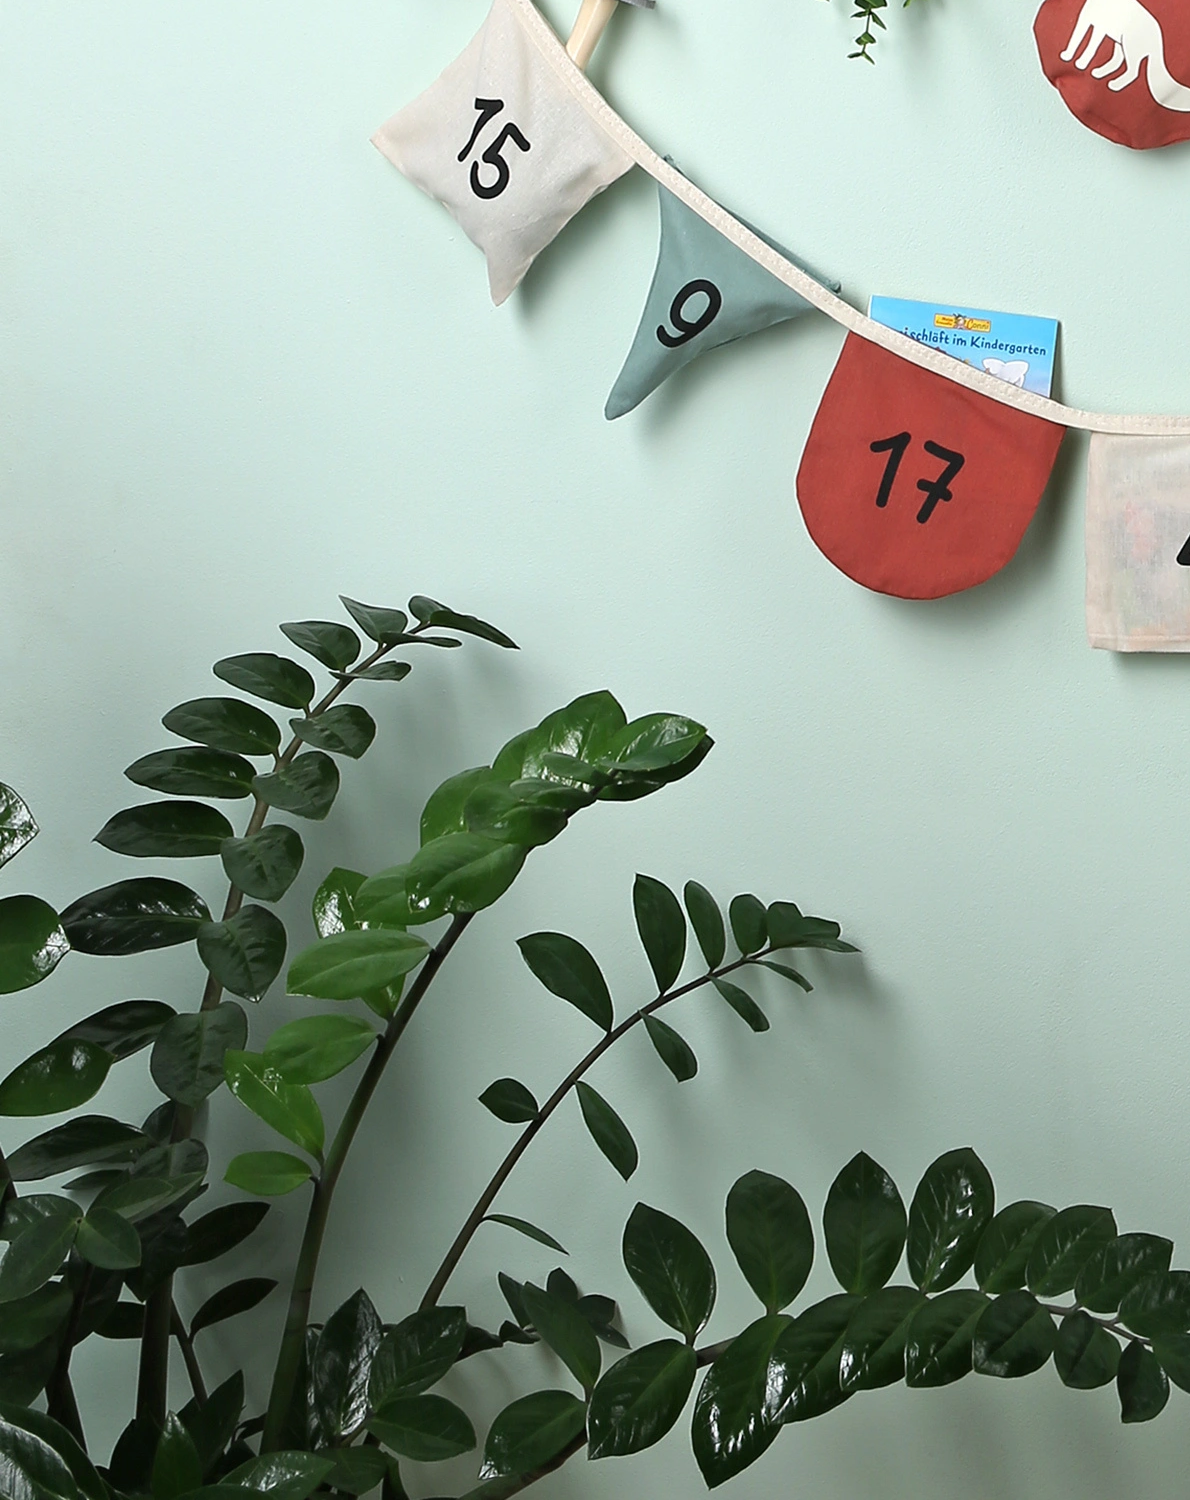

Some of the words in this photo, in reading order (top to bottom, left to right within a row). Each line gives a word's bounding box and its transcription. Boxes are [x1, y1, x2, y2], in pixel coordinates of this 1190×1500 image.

[457, 97, 531, 200] 15
[656, 279, 722, 349] 9
[910, 328, 949, 344] schläft
[952, 333, 967, 346] im
[970, 336, 1046, 356] Kindergarten
[966, 318, 990, 331] Conni
[870, 431, 965, 524] 17
